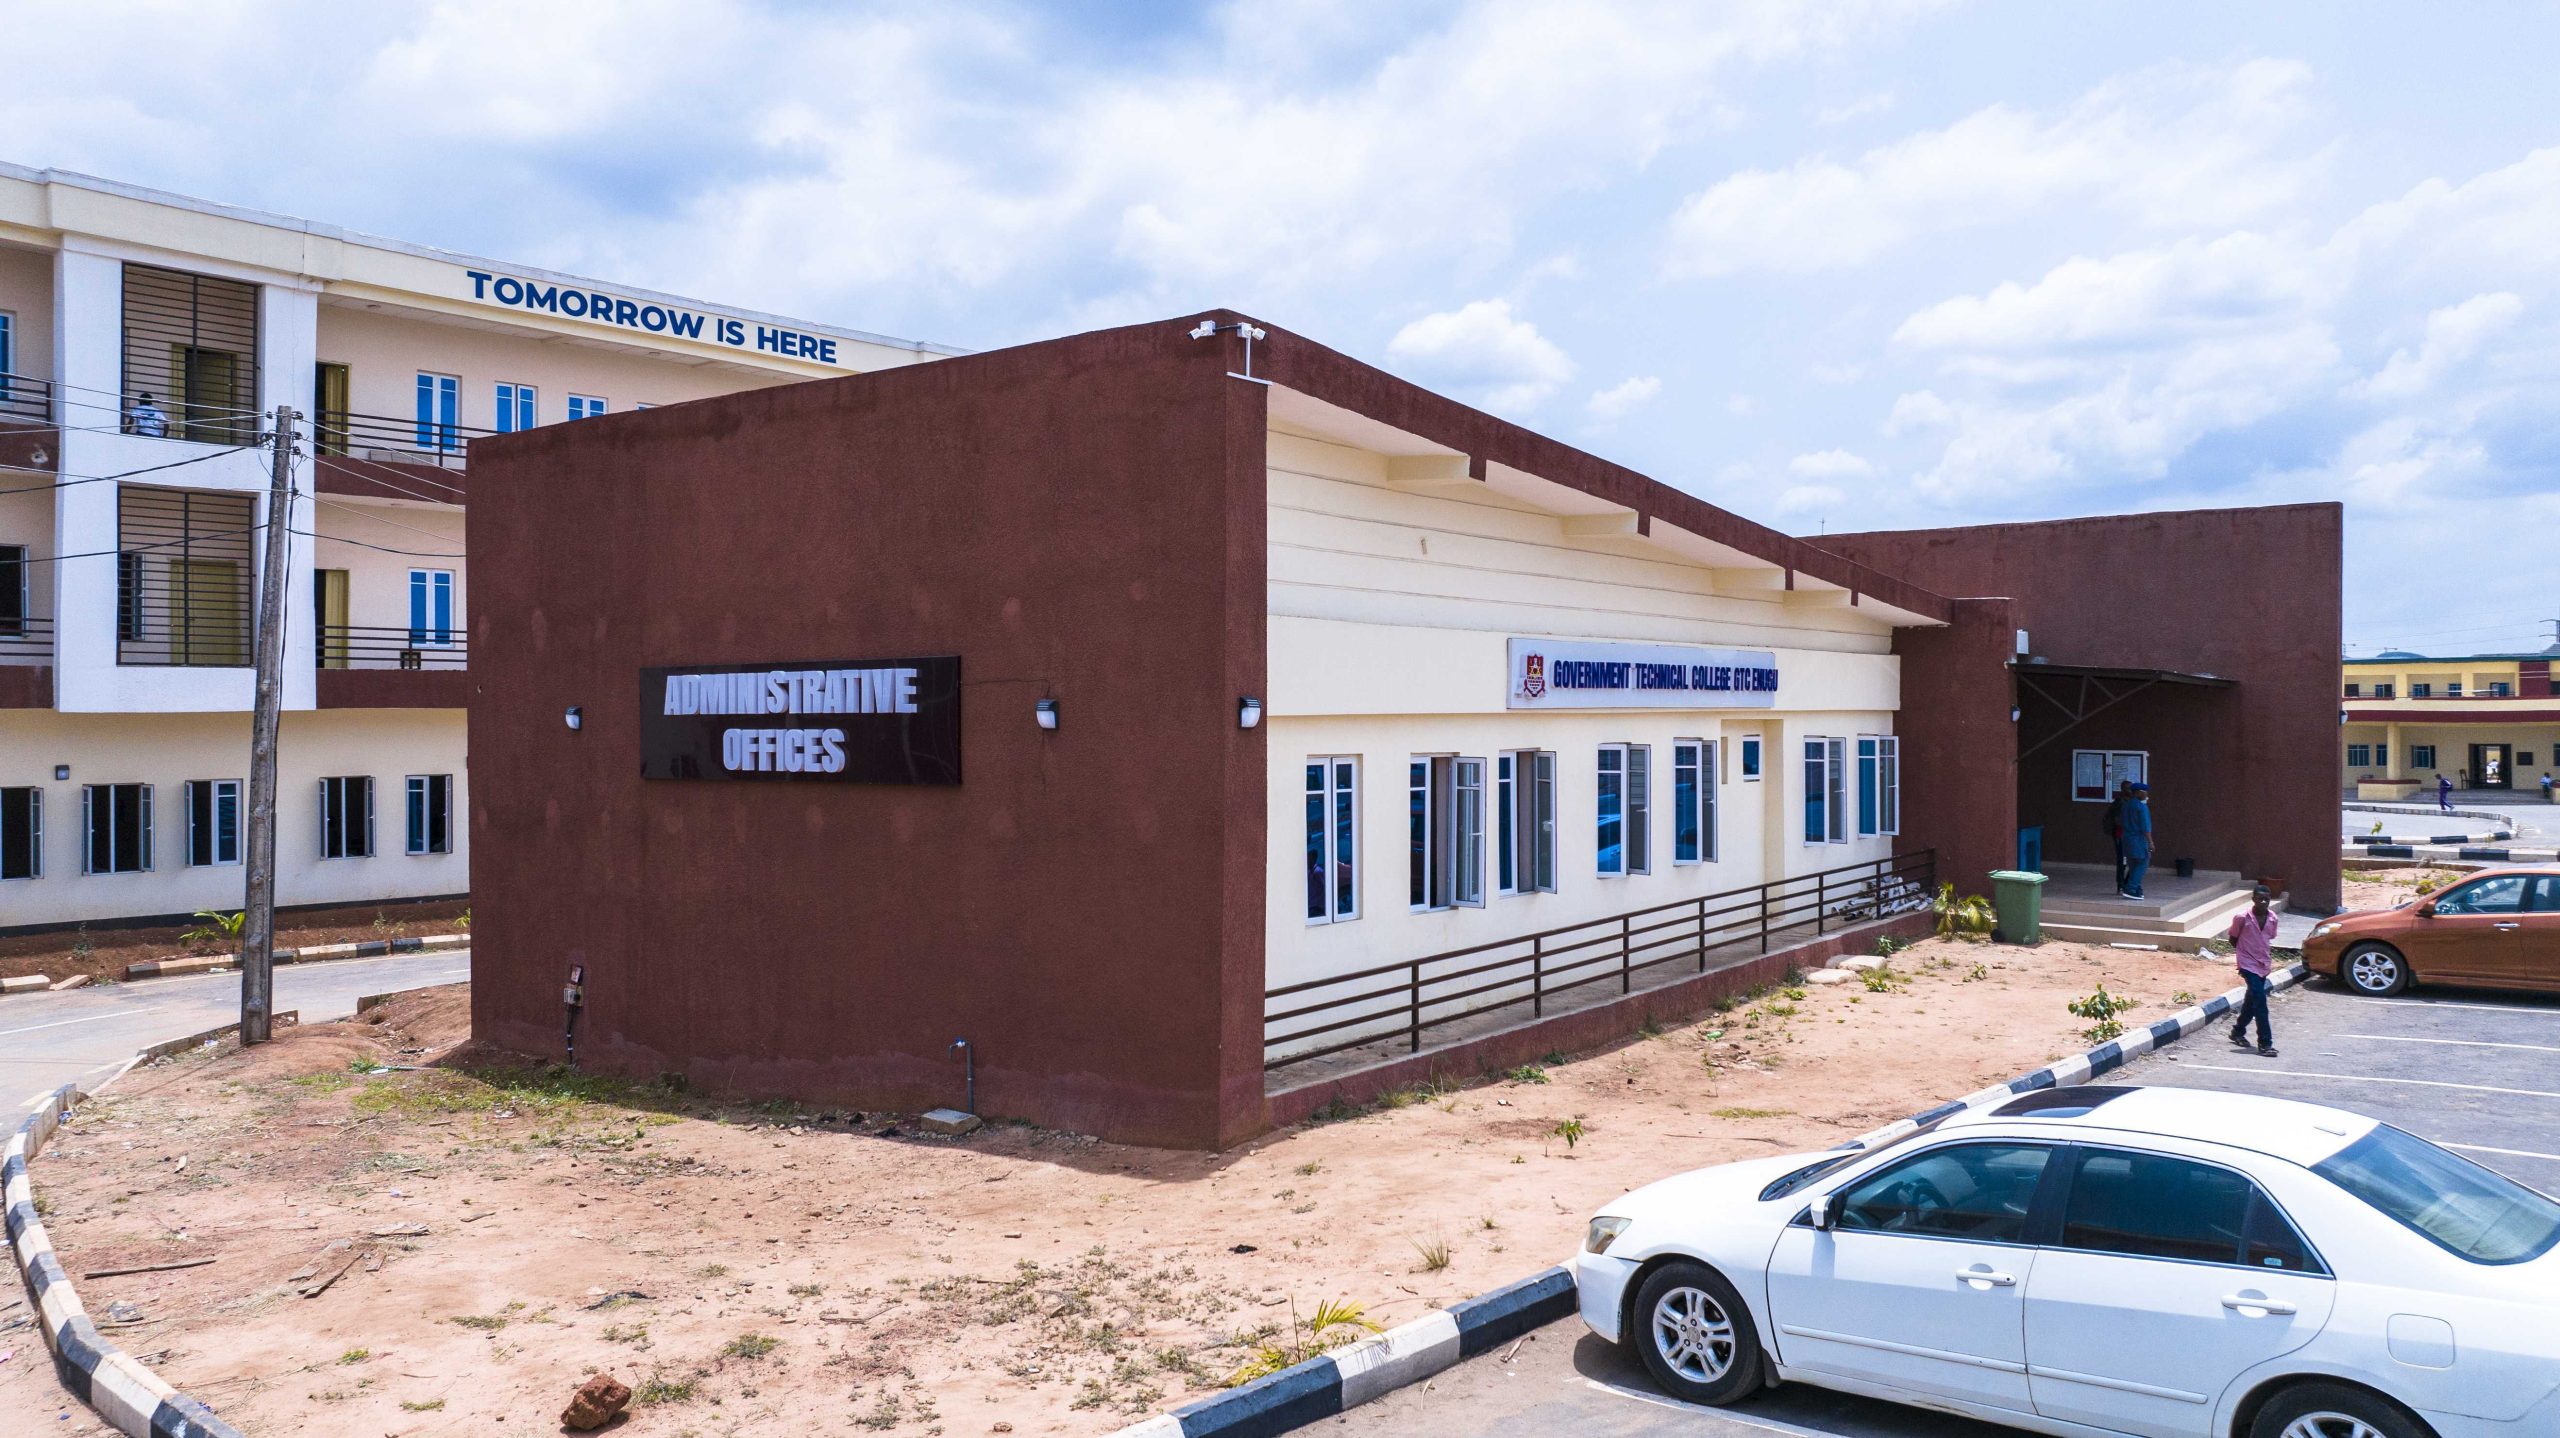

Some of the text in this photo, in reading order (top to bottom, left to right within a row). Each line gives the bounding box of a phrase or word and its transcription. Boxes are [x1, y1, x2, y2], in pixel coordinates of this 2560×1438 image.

[467, 270, 837, 363] TOMORROW IS HERE
[664, 668, 918, 715] ADMINISTRATIVE
[1554, 660, 1631, 688] GOVERNMENT
[1635, 663, 1688, 689] TECHNICAL
[1692, 665, 1731, 691] COLLEGE
[1734, 667, 1751, 691] GTC
[722, 728, 846, 773] OFFICES
